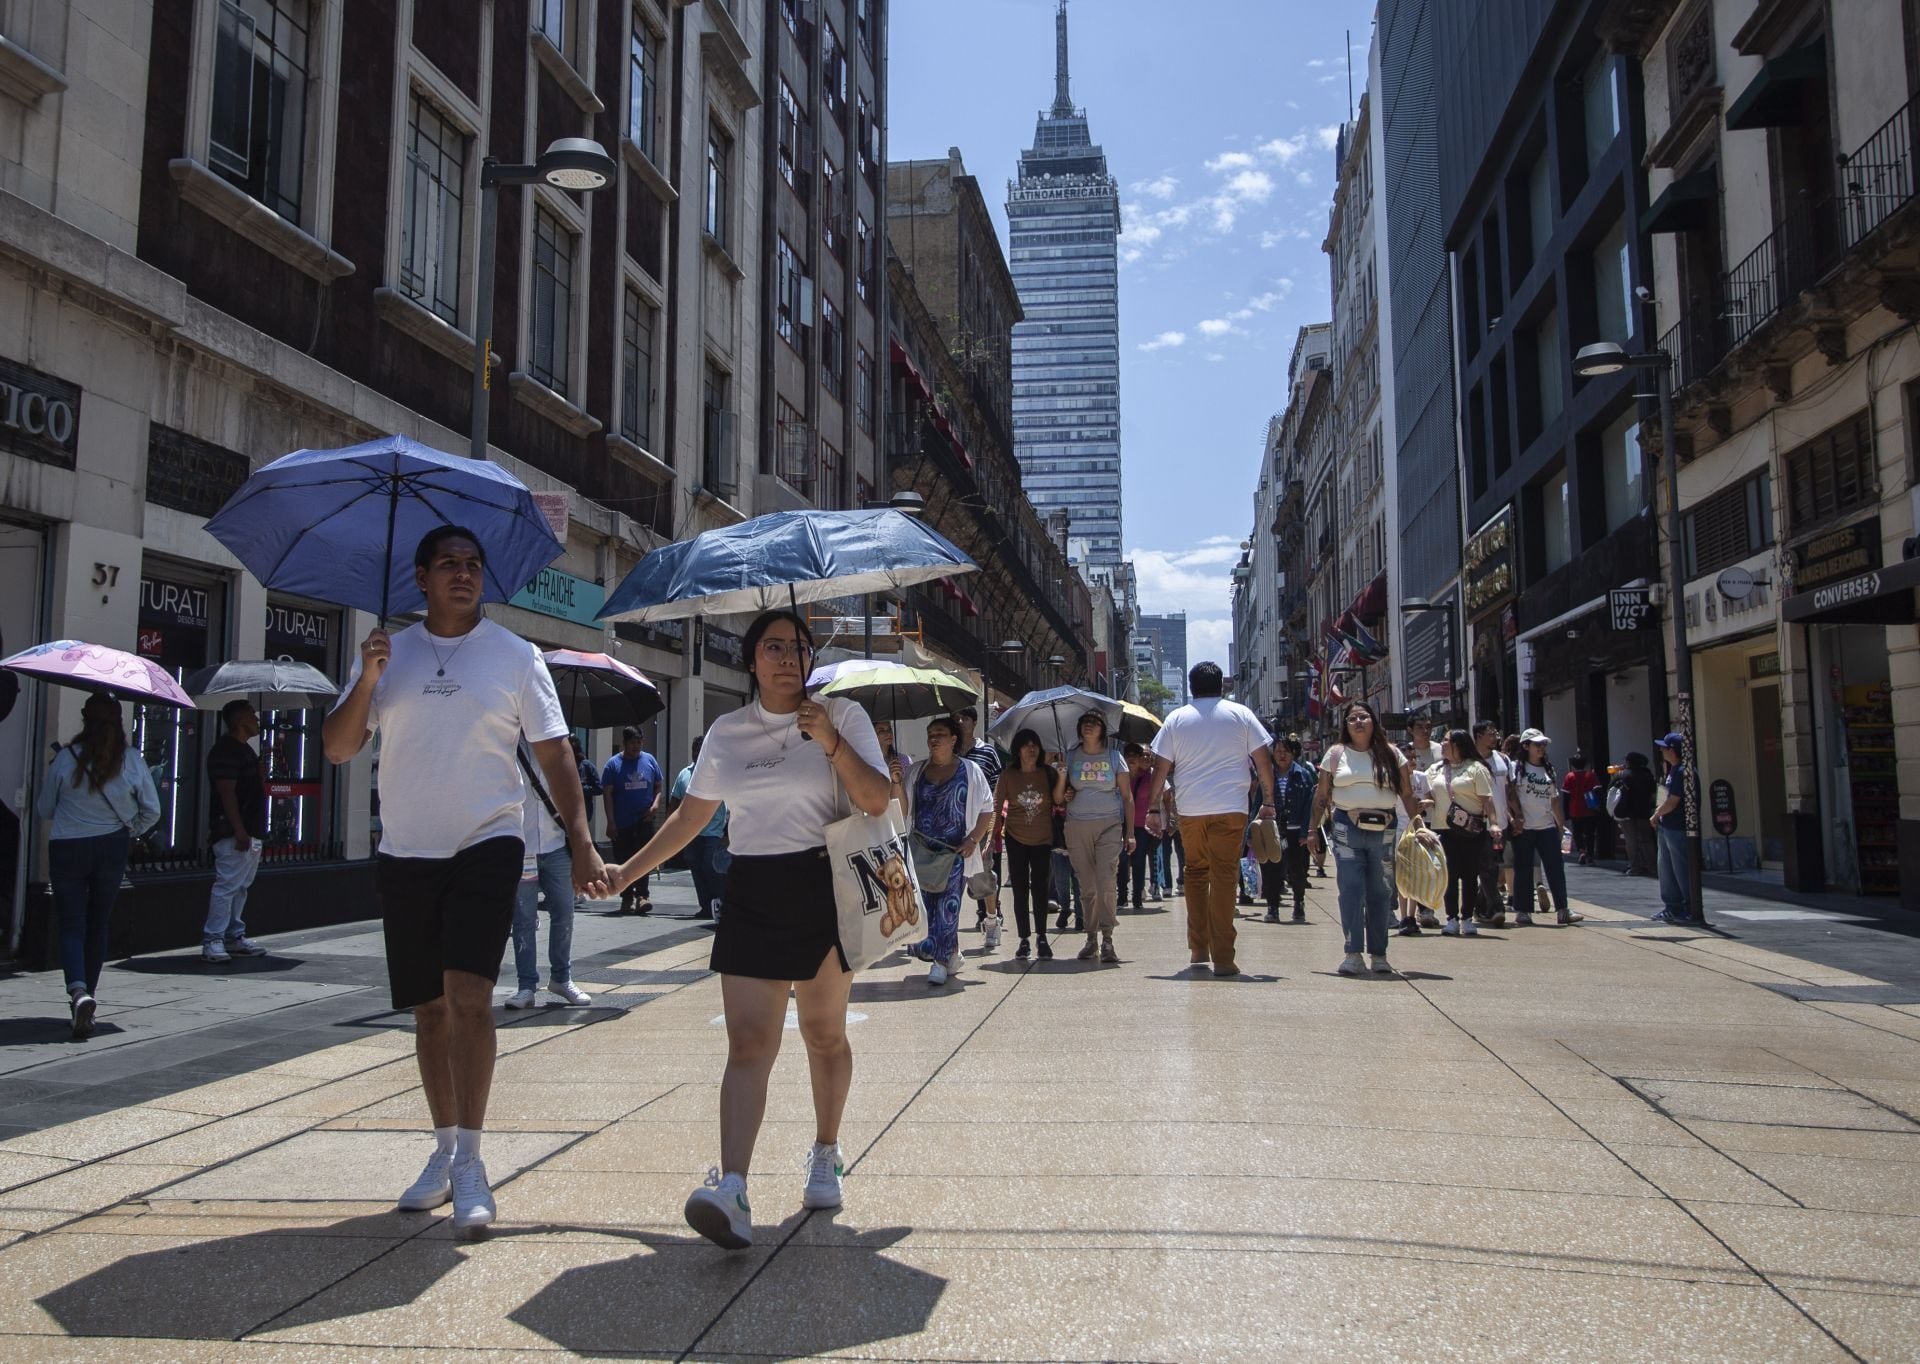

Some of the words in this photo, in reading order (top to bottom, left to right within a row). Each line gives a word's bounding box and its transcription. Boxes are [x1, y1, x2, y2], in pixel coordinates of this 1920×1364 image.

[1013, 187, 1109, 201] LATINOAMERICANA
[91, 562, 120, 588] 37
[537, 570, 576, 608] FRAICHE
[1813, 578, 1870, 609] CONVERSE
[140, 580, 209, 619] TURATI
[1614, 592, 1641, 605] INN
[1615, 605, 1649, 618] VICT
[177, 615, 195, 625] DESDE
[275, 608, 328, 640] TURATI
[1615, 617, 1637, 630] US
[1073, 761, 1110, 771] GOOD
[1073, 771, 1113, 781] VIBES
